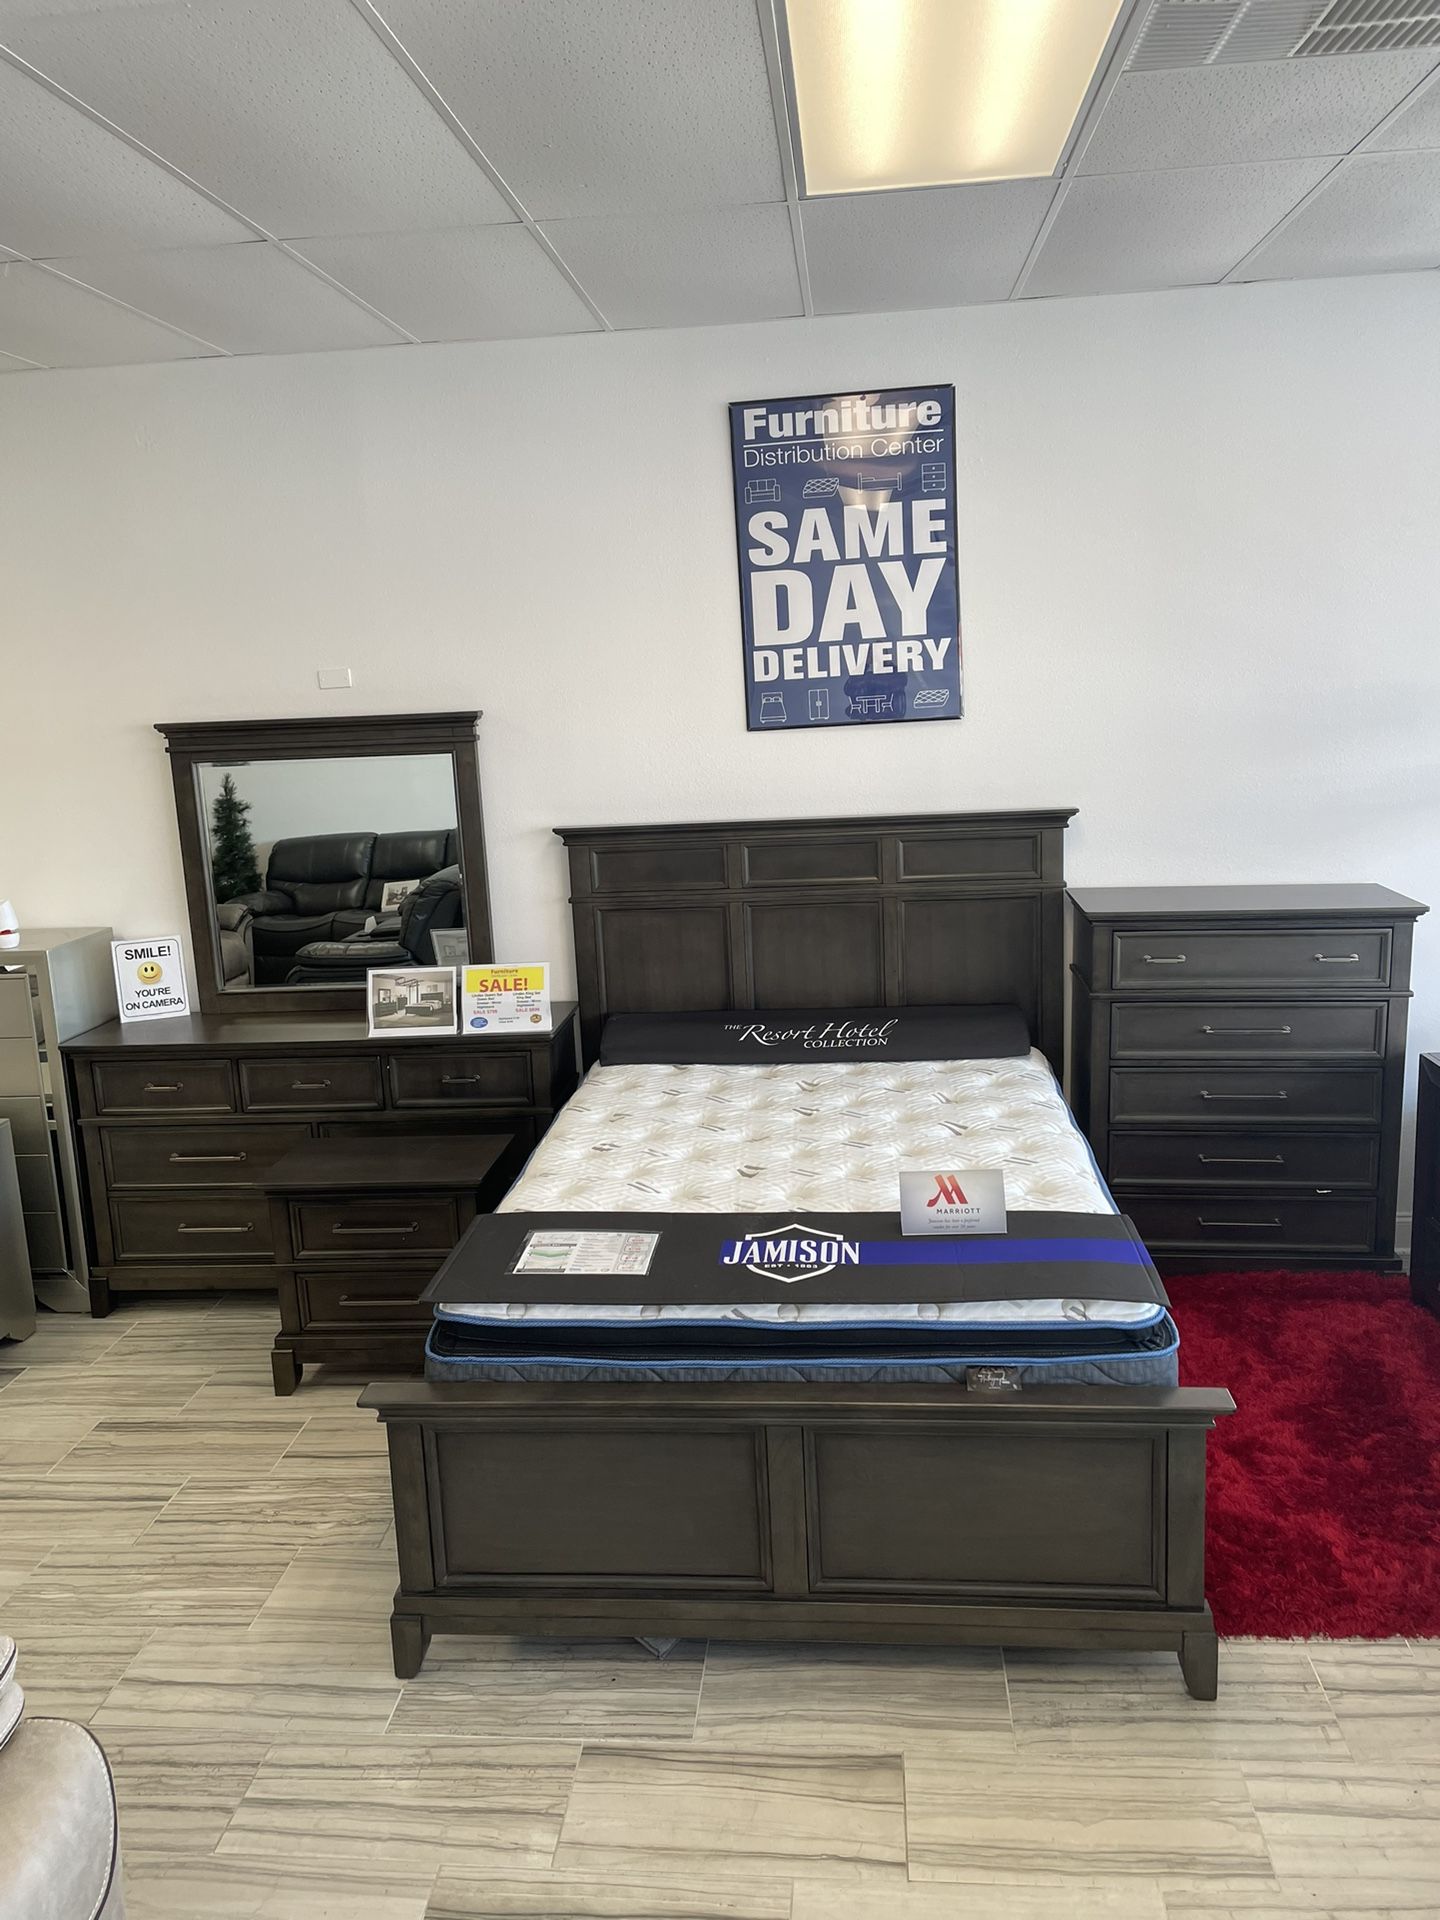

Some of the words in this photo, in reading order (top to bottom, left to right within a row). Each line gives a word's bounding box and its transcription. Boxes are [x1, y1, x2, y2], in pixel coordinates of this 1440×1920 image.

[743, 400, 942, 440] Furniture
[744, 442, 863, 468] Distribution
[871, 436, 945, 458] Center
[748, 498, 948, 566] SAME
[751, 558, 947, 647] DAY
[753, 638, 951, 682] DELIVERY
[124, 945, 171, 960] SMILE!
[135, 987, 171, 998] YOU'RE
[479, 978, 528, 992] SALE!
[125, 1002, 140, 1011] ON
[142, 997, 184, 1009] CAMERA
[738, 1024, 817, 1046] Resort
[819, 1018, 899, 1039] Hotel
[803, 1038, 889, 1048] COLLECTION
[723, 1240, 860, 1265] JAMISON
